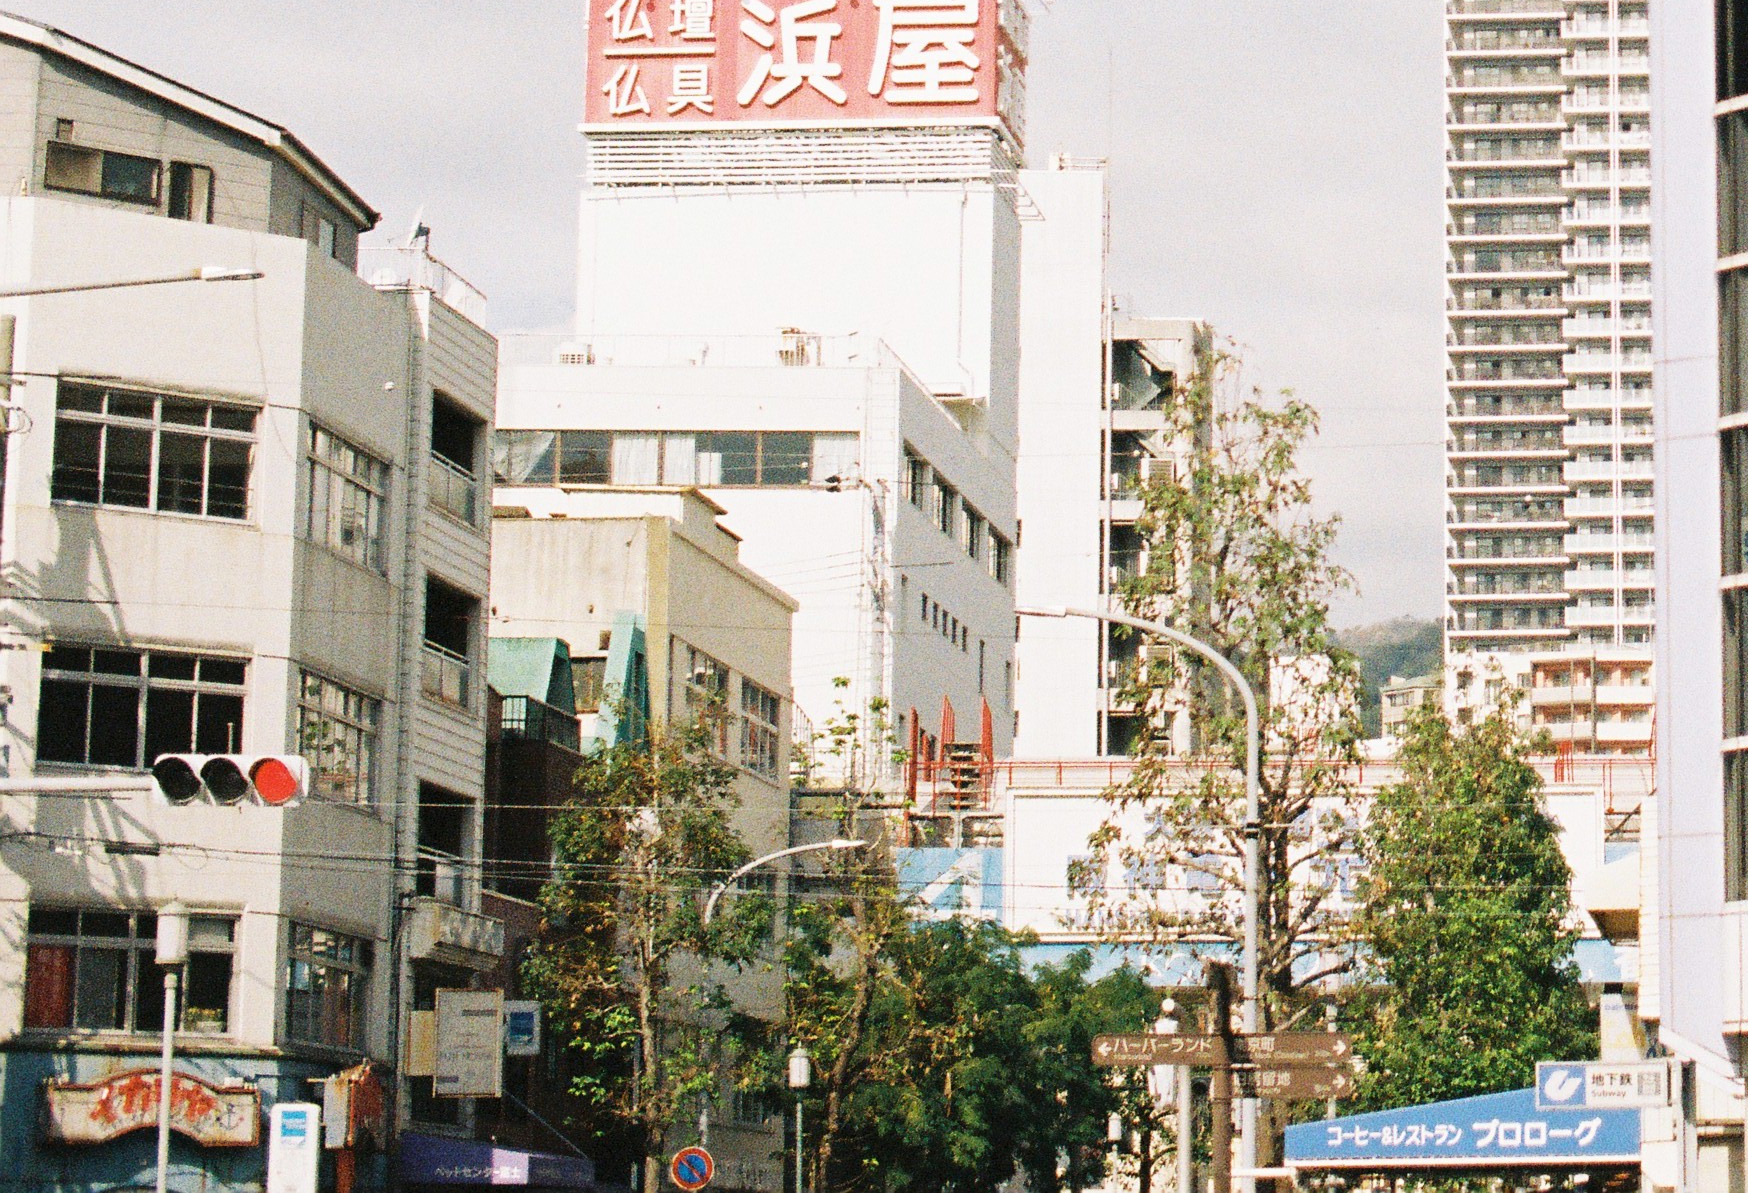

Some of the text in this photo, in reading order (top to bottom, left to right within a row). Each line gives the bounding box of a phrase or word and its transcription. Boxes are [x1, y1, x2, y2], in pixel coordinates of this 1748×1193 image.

[601, 64, 715, 116] 仏具
[1113, 1037, 1213, 1053] ハーバーランド
[1591, 1072, 1633, 1087] 地下鉄
[1327, 1116, 1603, 1149] コーヒー&レストラン プロローグ
